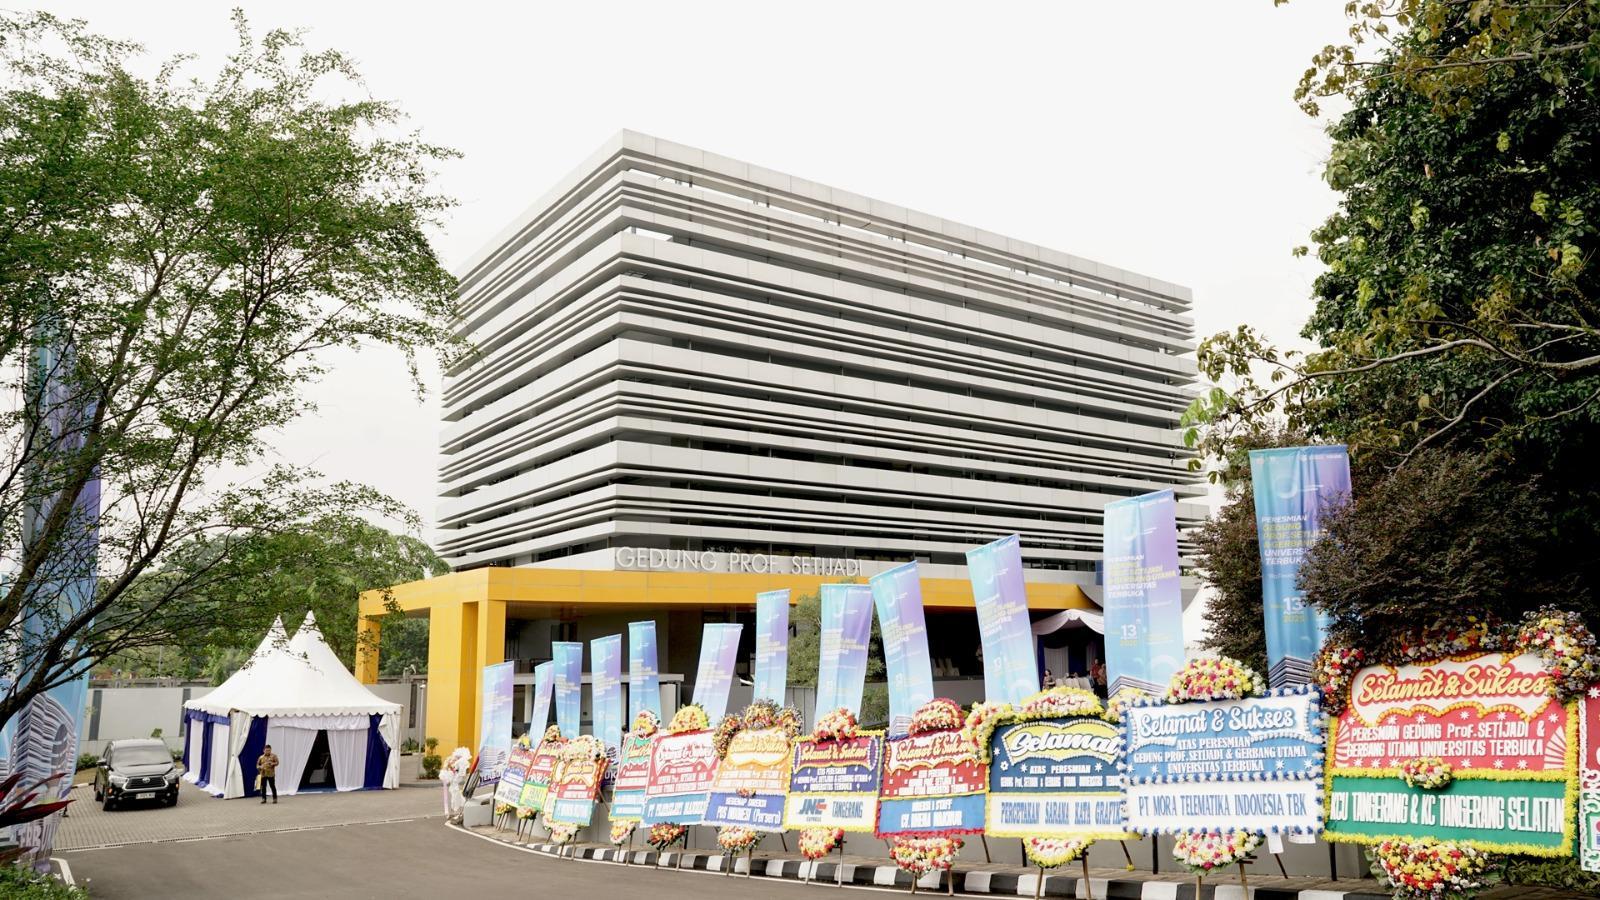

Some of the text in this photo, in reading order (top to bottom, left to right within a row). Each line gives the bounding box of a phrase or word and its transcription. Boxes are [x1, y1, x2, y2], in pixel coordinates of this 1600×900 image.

[616, 547, 862, 576] GEDUNG PROF. SETIJADI
[1283, 597, 1303, 611] 13
[1121, 624, 1137, 638] 13
[1360, 667, 1546, 702] Selamat & Sukses
[1140, 706, 1294, 737] Selamat & Sukses
[1403, 723, 1441, 739] GEDUNG
[1536, 720, 1545, 736] &
[1176, 736, 1251, 750] ATAS PERESMIAN
[1388, 741, 1419, 757] UTAMA
[1420, 740, 1486, 756] UNIVERSITAS
[1489, 739, 1544, 756] TERBUKA
[1134, 750, 1163, 763] GEDUNG
[1225, 748, 1233, 759] &
[1235, 747, 1276, 759] GERBANG
[1277, 745, 1308, 757] UTAMA
[1167, 759, 1264, 774] UNIVERSITAS TERBUKA
[799, 799, 863, 818] JNE TANGERANG
[1138, 793, 1307, 816] PT MORA TELEMATIKA INDONESIA TBK
[1351, 791, 1409, 824] TANGERANG
[1410, 793, 1419, 824] &
[1420, 793, 1436, 825] KC
[1438, 794, 1505, 829] TANGERANG
[1507, 796, 1564, 833] SELATAN
